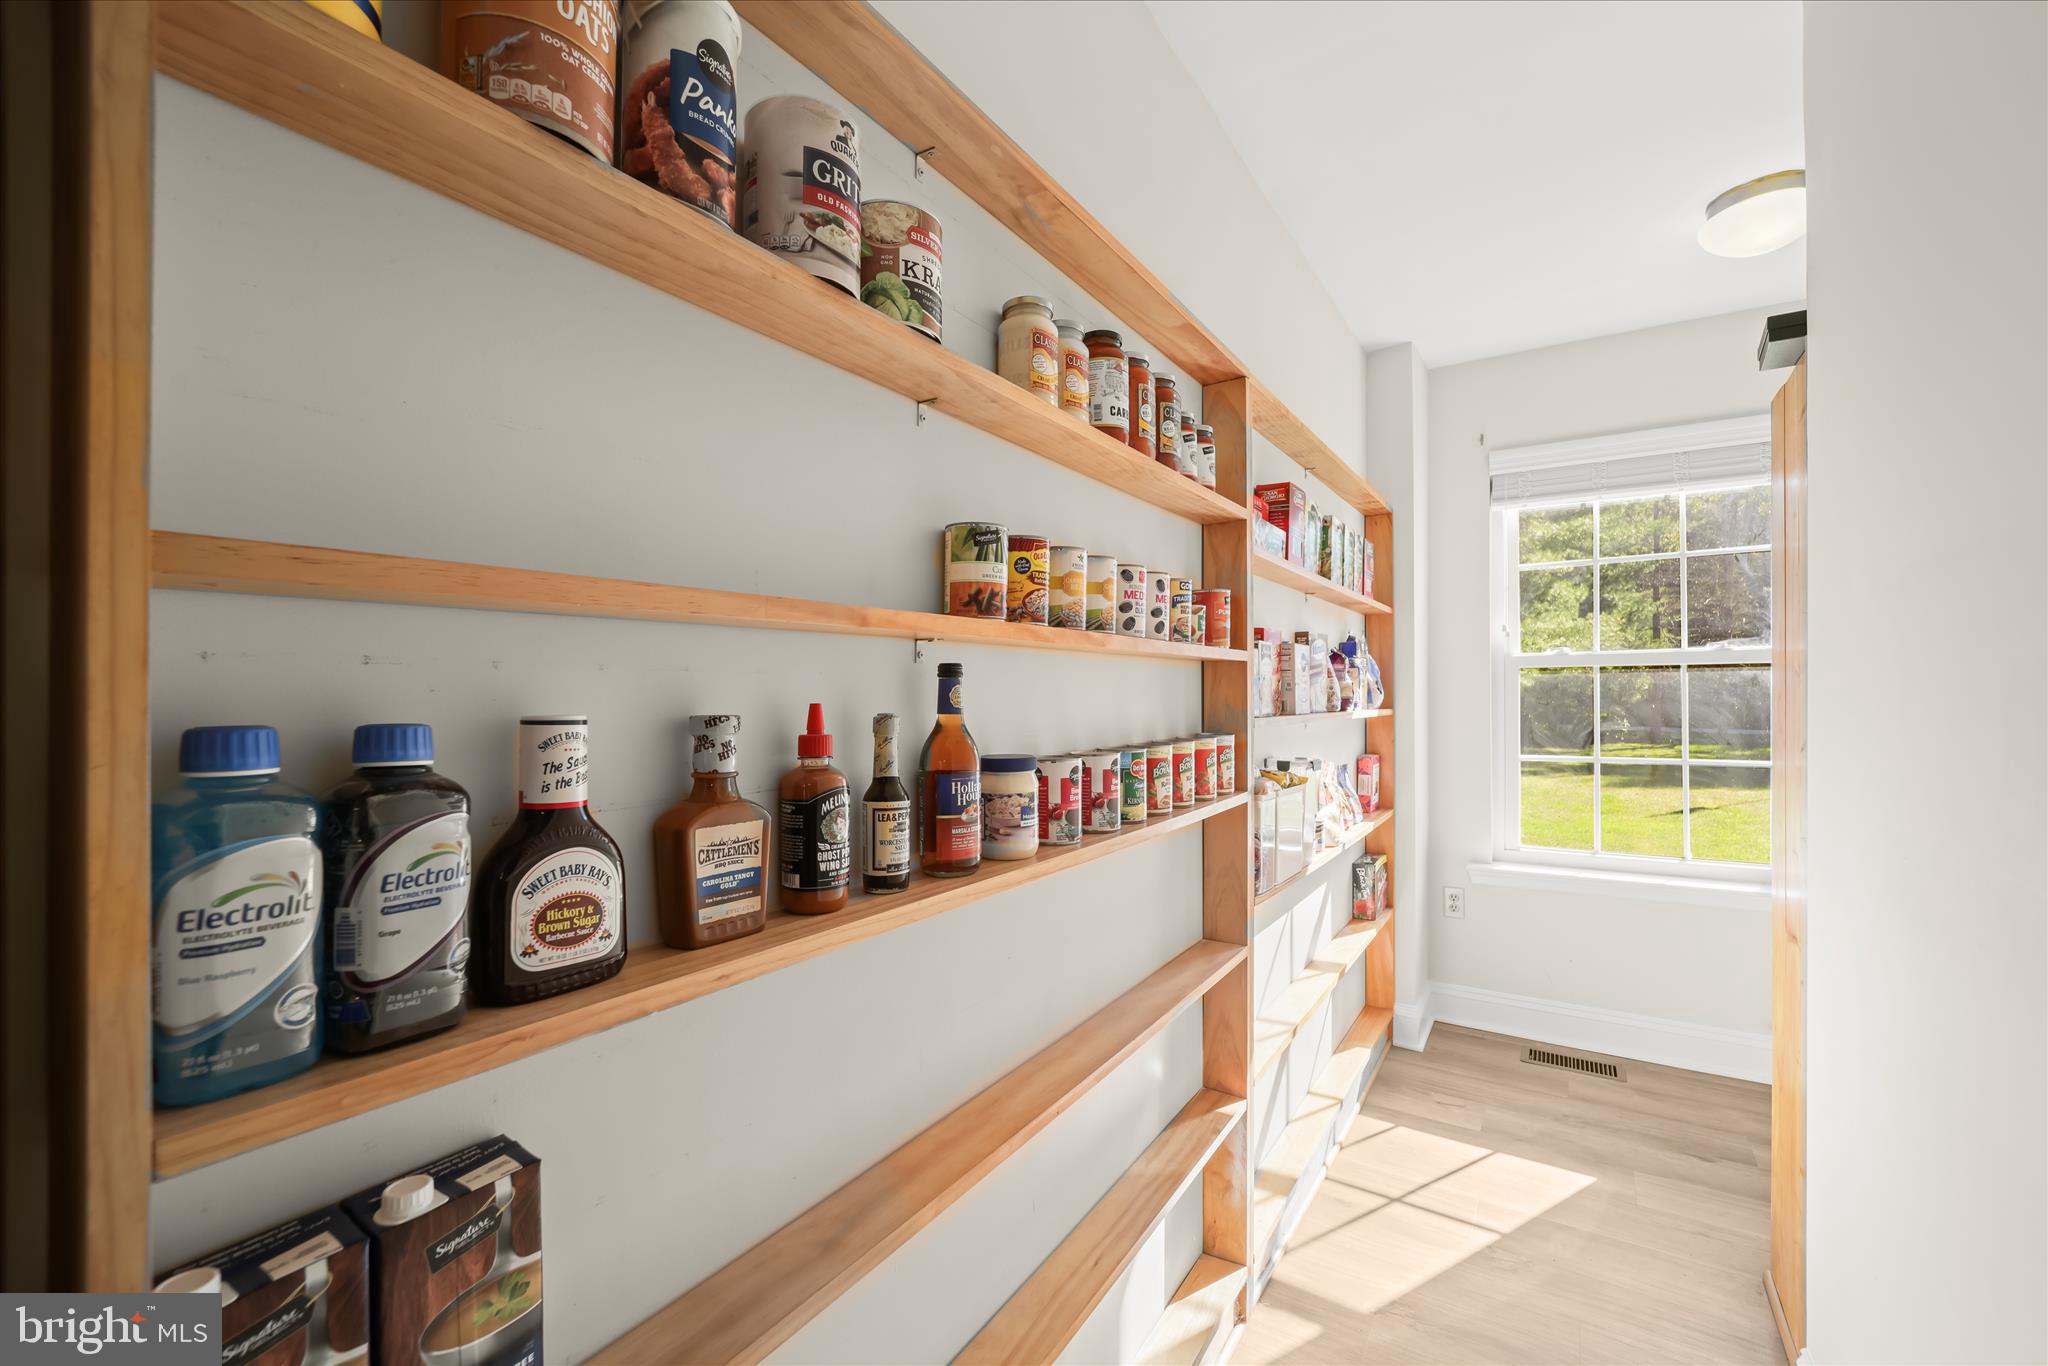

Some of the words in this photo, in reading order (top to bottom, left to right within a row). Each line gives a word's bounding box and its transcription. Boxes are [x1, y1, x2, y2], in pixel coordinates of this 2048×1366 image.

[556, 0, 610, 54] OATS
[540, 32, 569, 53] 100%
[570, 47, 600, 77] WHOLE
[561, 52, 580, 68] OAT
[688, 109, 715, 128] BREAD
[817, 193, 834, 205] OLD
[537, 733, 563, 753] SWEET
[542, 761, 563, 776] The
[541, 780, 551, 793] is
[555, 776, 573, 791] the
[952, 827, 971, 835] MARSALA
[817, 849, 840, 861] GHOST
[714, 861, 727, 869] BBQ
[819, 859, 840, 872] WING
[379, 861, 470, 894] Electrolit
[522, 868, 557, 900] SWEET
[559, 863, 588, 877] BABY
[588, 865, 613, 887] RAY'S
[702, 875, 735, 888] CAROLINA
[735, 871, 755, 880] TANGY
[383, 887, 433, 903] ELECTROLYTE
[176, 893, 314, 934] Electrolit
[546, 905, 586, 922] Hickory
[587, 904, 595, 914] &
[182, 926, 254, 945] ELECTROLYTE
[256, 917, 305, 933] BEVERAGE
[538, 921, 571, 935] Brown
[573, 913, 601, 928] Sugar
[378, 928, 401, 938] Grape
[546, 930, 576, 942] Barbecue
[576, 927, 595, 936] Sauce
[434, 1215, 494, 1259] Signature
